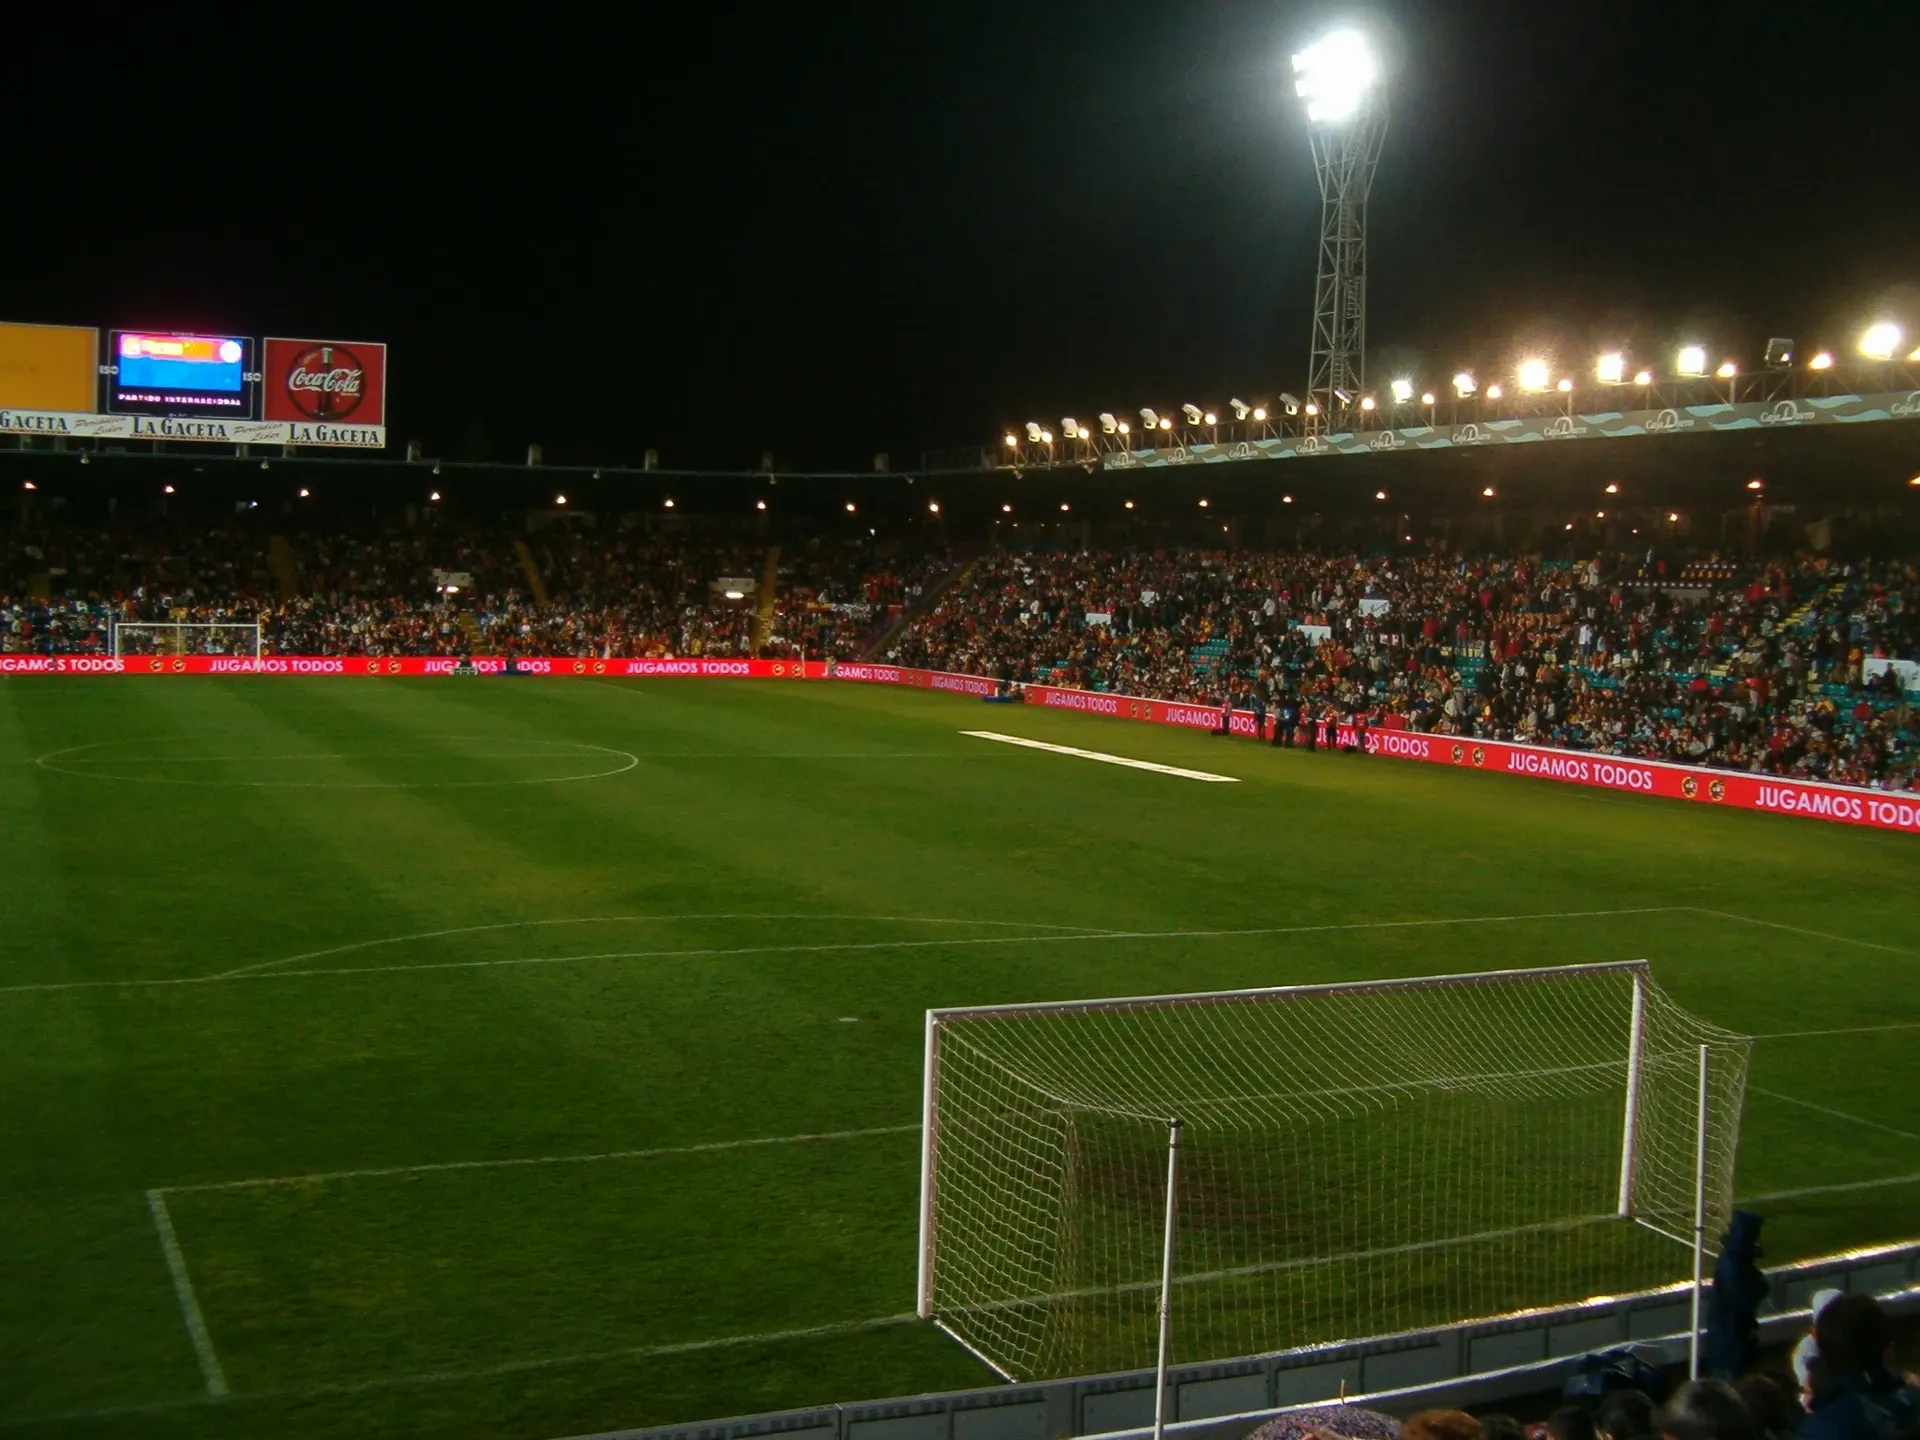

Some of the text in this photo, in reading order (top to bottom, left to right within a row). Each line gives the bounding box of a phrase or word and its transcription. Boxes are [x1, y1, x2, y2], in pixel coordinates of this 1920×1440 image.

[0, 411, 69, 430] GACETA
[133, 416, 227, 437] LA GACETA
[290, 424, 379, 443] LA GACETA
[0, 659, 125, 671] GAMOS TODOS
[210, 660, 343, 672] JUGAMOS TODOS
[628, 662, 749, 674] JUGAMOS TODOS
[822, 666, 900, 681] JGAMOS TODOS
[931, 675, 989, 694] JUGAMOS TODOS
[1045, 692, 1117, 713] JUGAMOS TODOS
[1165, 707, 1216, 728] JUGAMOS
[1383, 735, 1430, 757] TODOS
[1508, 752, 1653, 790] JUGAMOS TODOS
[1755, 786, 1920, 828] JUGAMOS TOD
